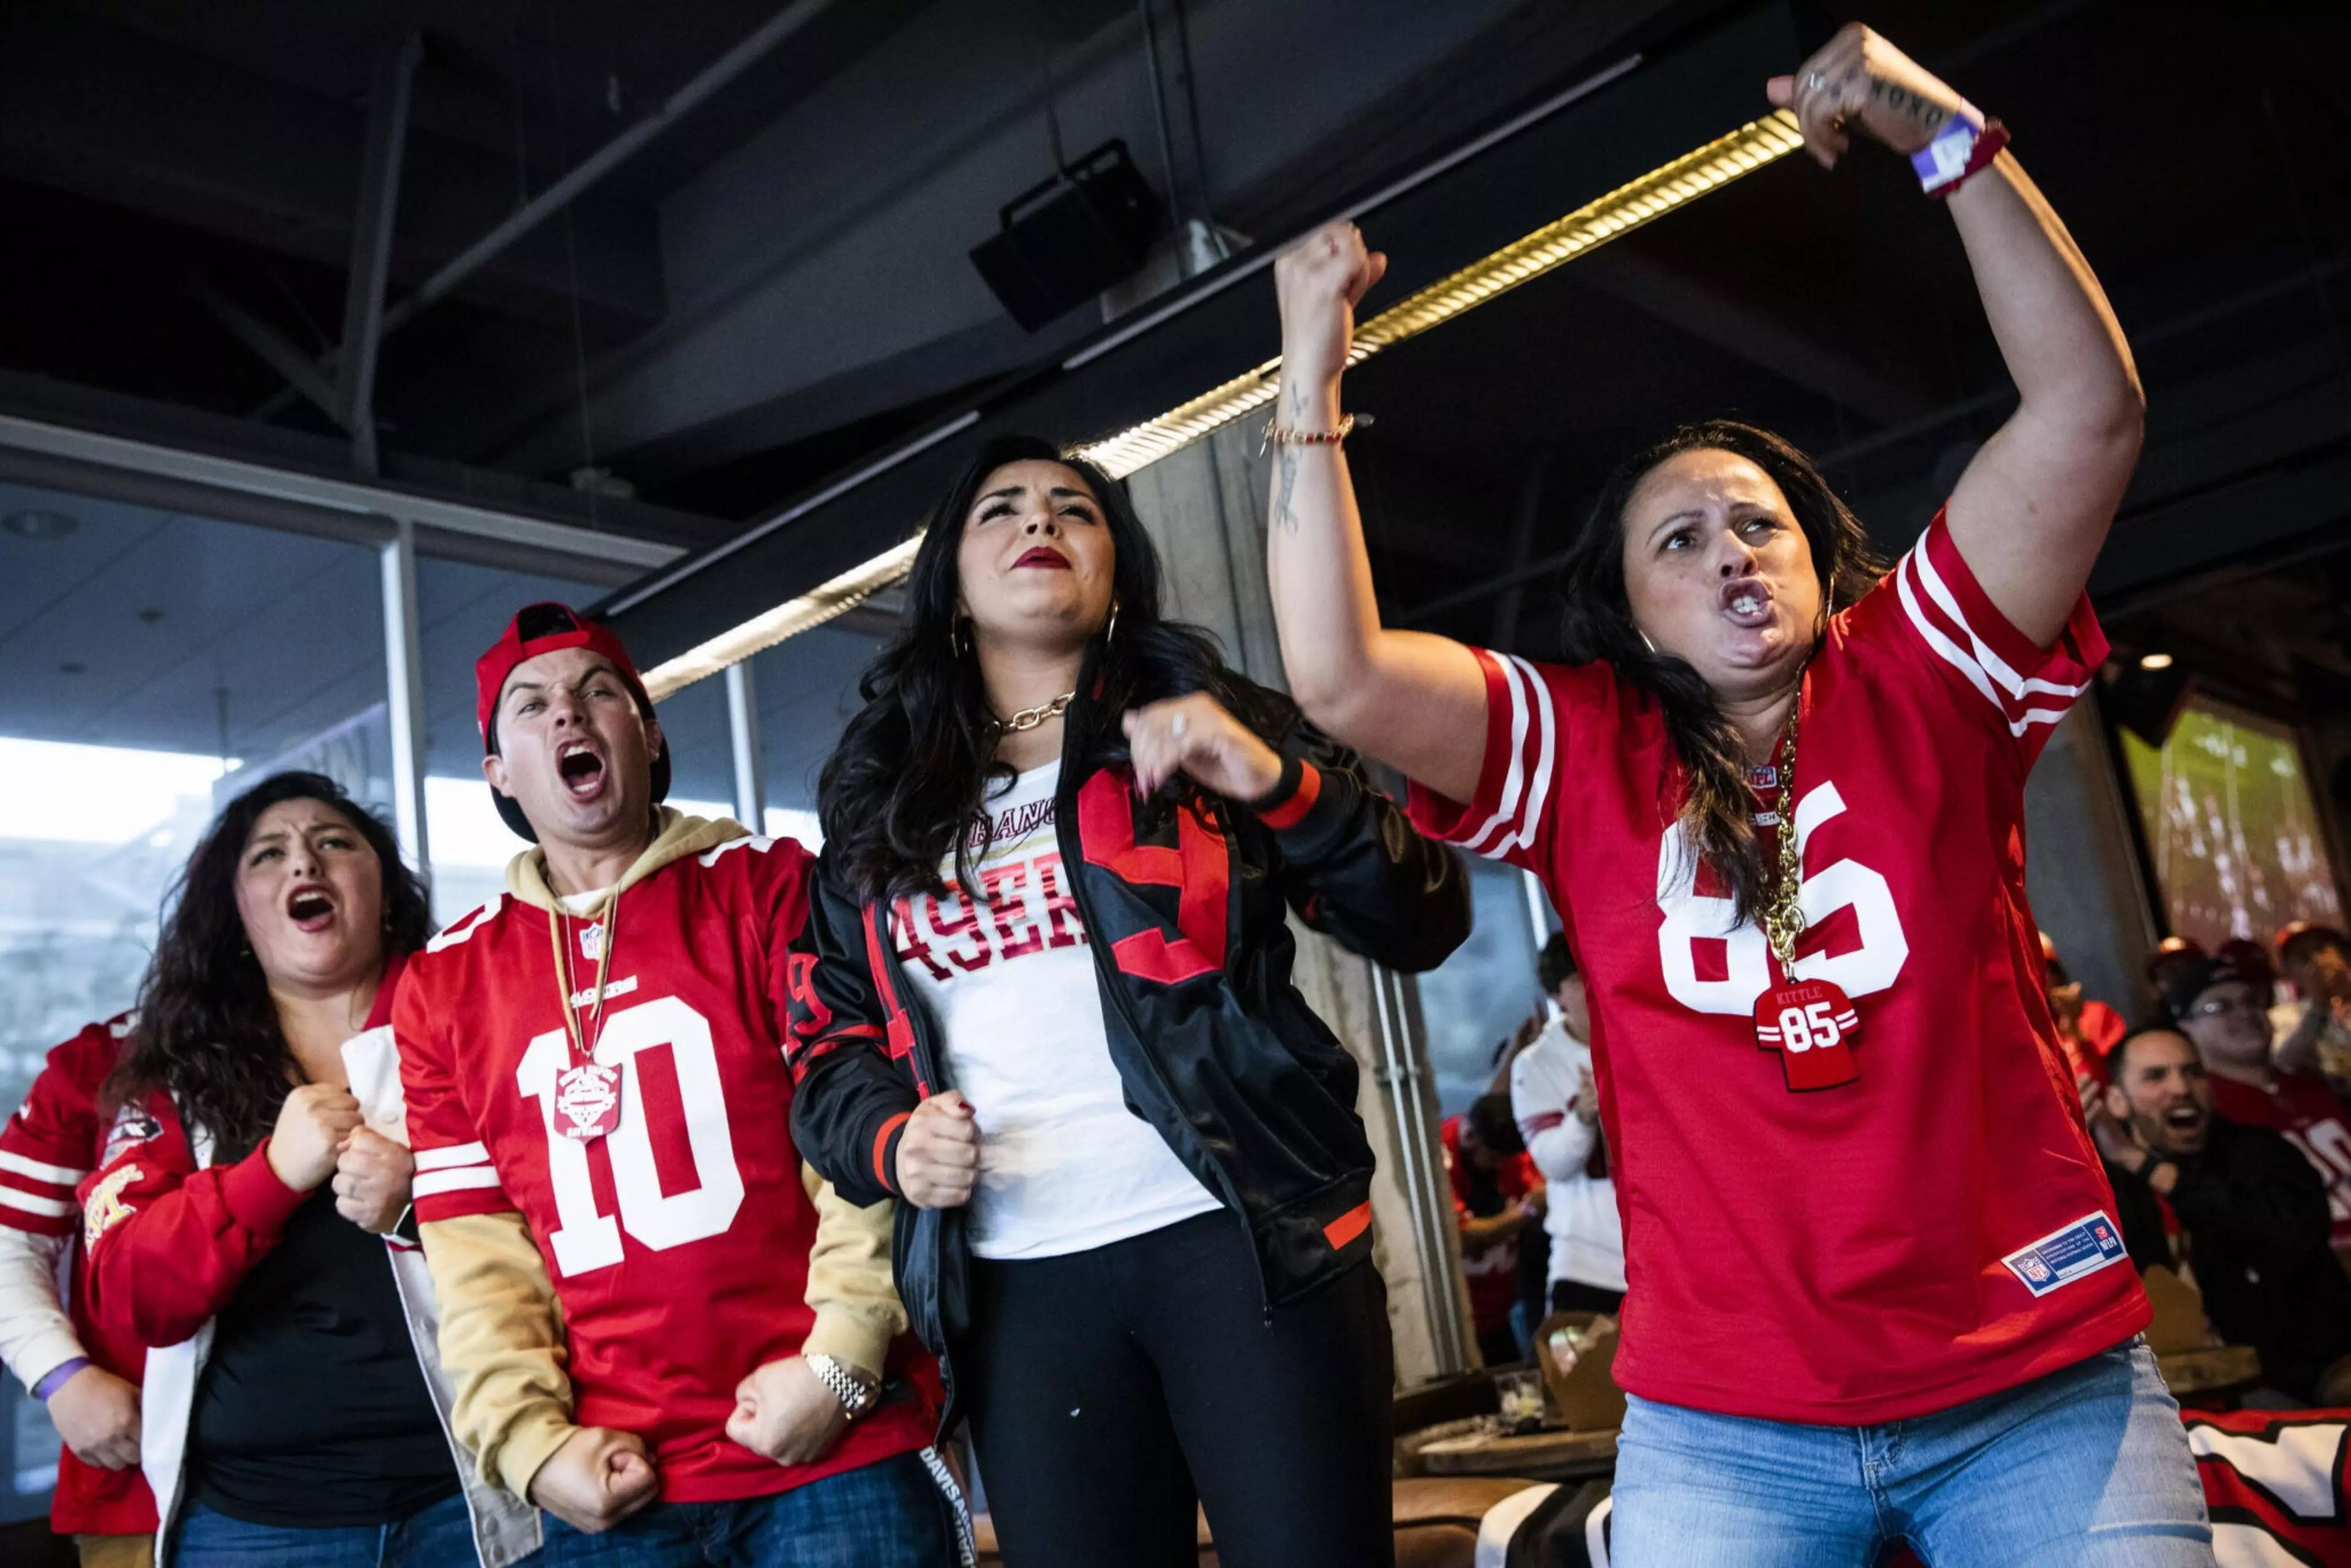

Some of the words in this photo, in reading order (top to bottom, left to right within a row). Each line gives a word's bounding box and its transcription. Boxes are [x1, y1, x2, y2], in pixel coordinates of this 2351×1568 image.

[1657, 780, 1910, 1017] 85
[1776, 986, 1822, 1005] KITTLE
[1779, 1001, 1840, 1054] 85
[517, 995, 744, 1278] 10
[2028, 1266, 2047, 1279] NFL
[919, 1446, 961, 1501] DAVIS
